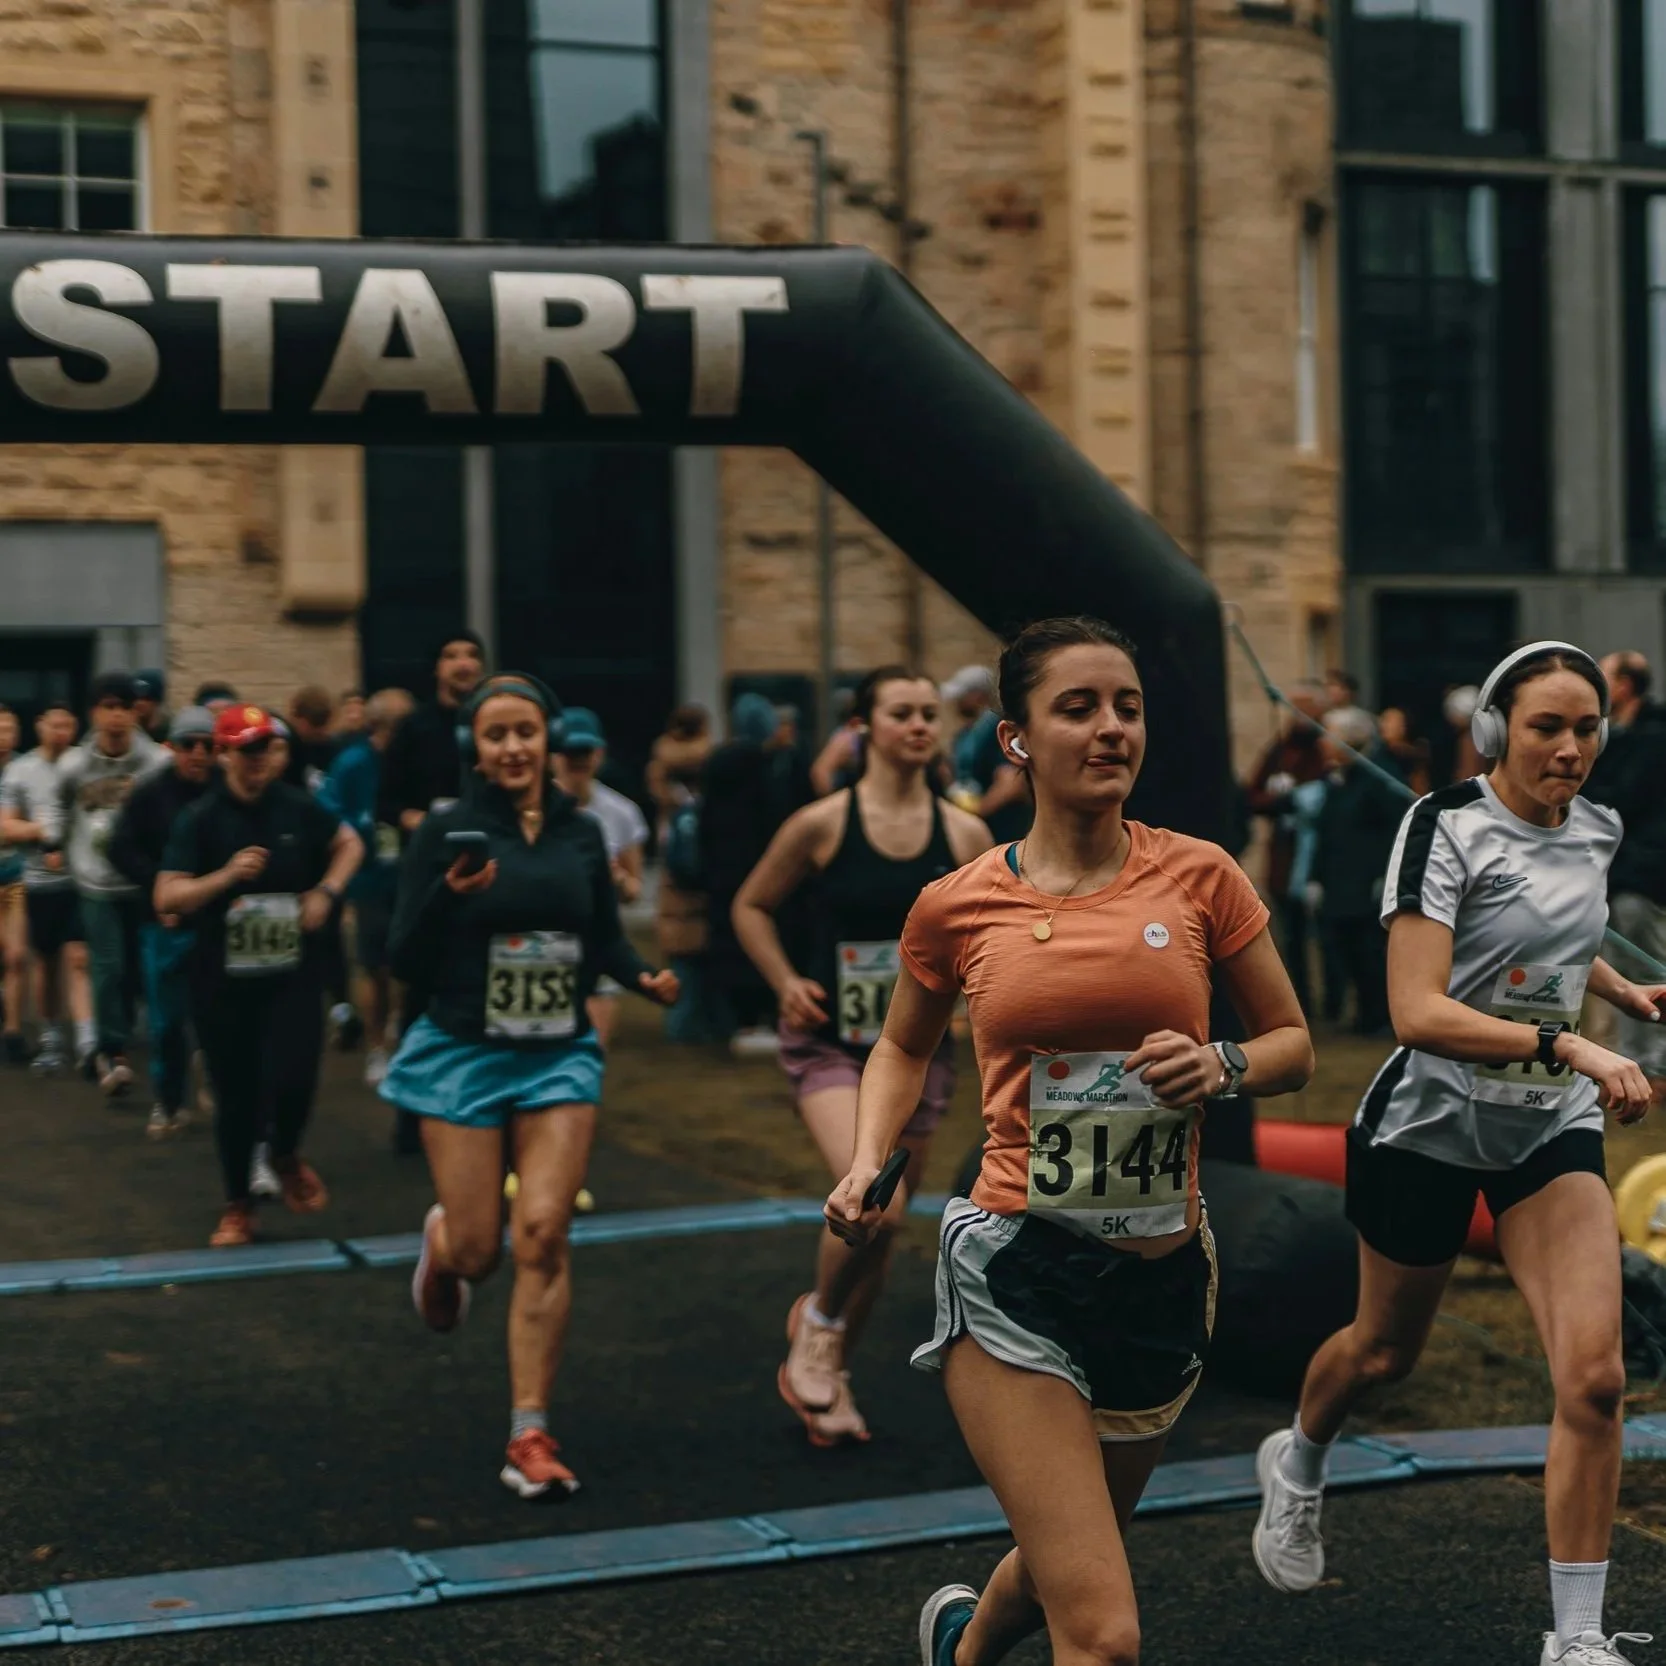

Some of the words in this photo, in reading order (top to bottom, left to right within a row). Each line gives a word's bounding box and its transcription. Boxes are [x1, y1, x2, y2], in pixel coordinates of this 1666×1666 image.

[8, 258, 789, 416] START
[843, 983, 886, 1025] 31
[1046, 1091, 1085, 1103] MEADOWS
[1086, 1092, 1128, 1103] MARATHON
[1524, 1090, 1546, 1105] 5K
[1033, 1122, 1188, 1197] 3144
[1101, 1215, 1131, 1235] 5K
